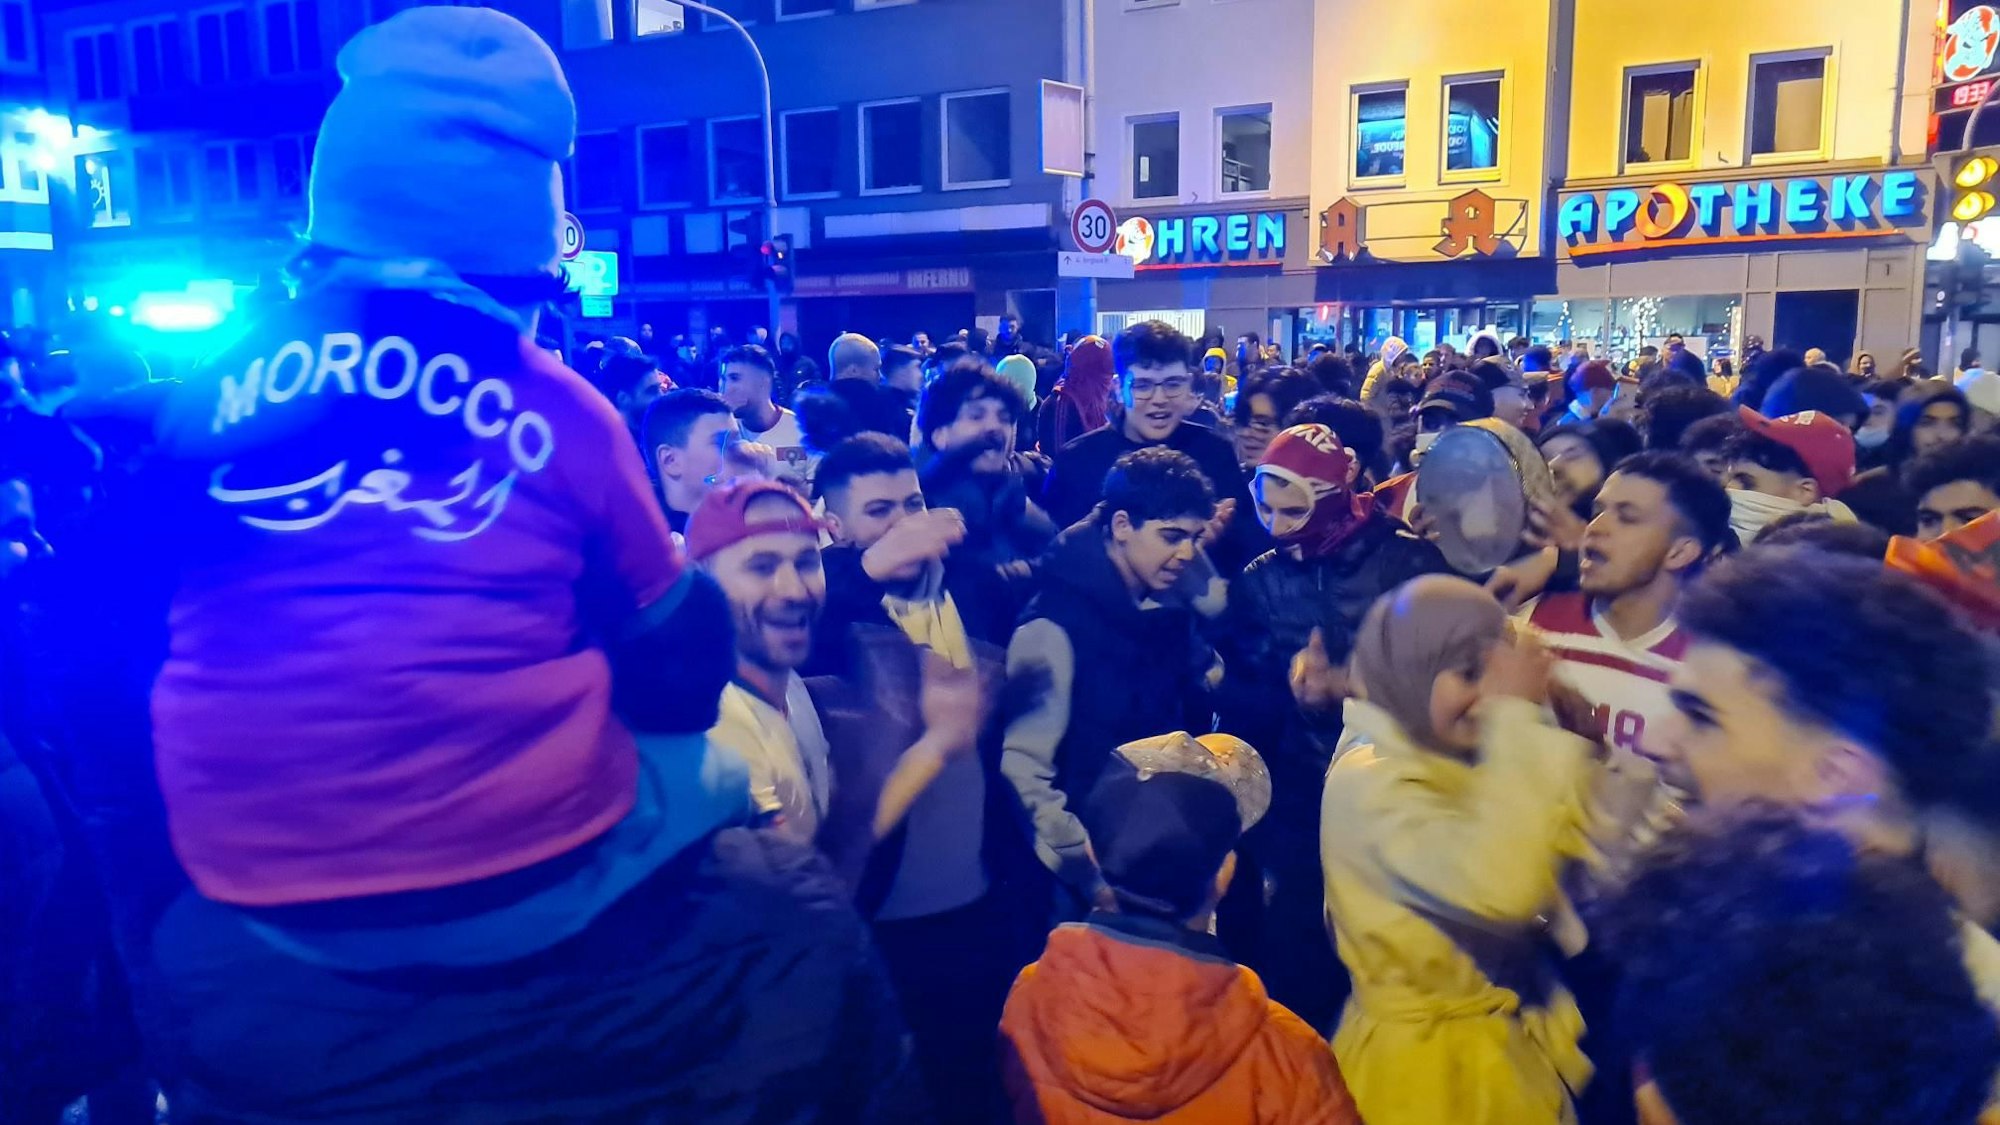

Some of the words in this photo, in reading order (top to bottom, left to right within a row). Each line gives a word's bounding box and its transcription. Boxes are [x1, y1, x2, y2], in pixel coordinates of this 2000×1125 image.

[566, 226, 576, 247] 0
[1081, 214, 1107, 240] 30
[1558, 172, 1916, 239] APOTHEKE
[212, 332, 554, 473] MOROCCO
[207, 448, 519, 542] المغرب
